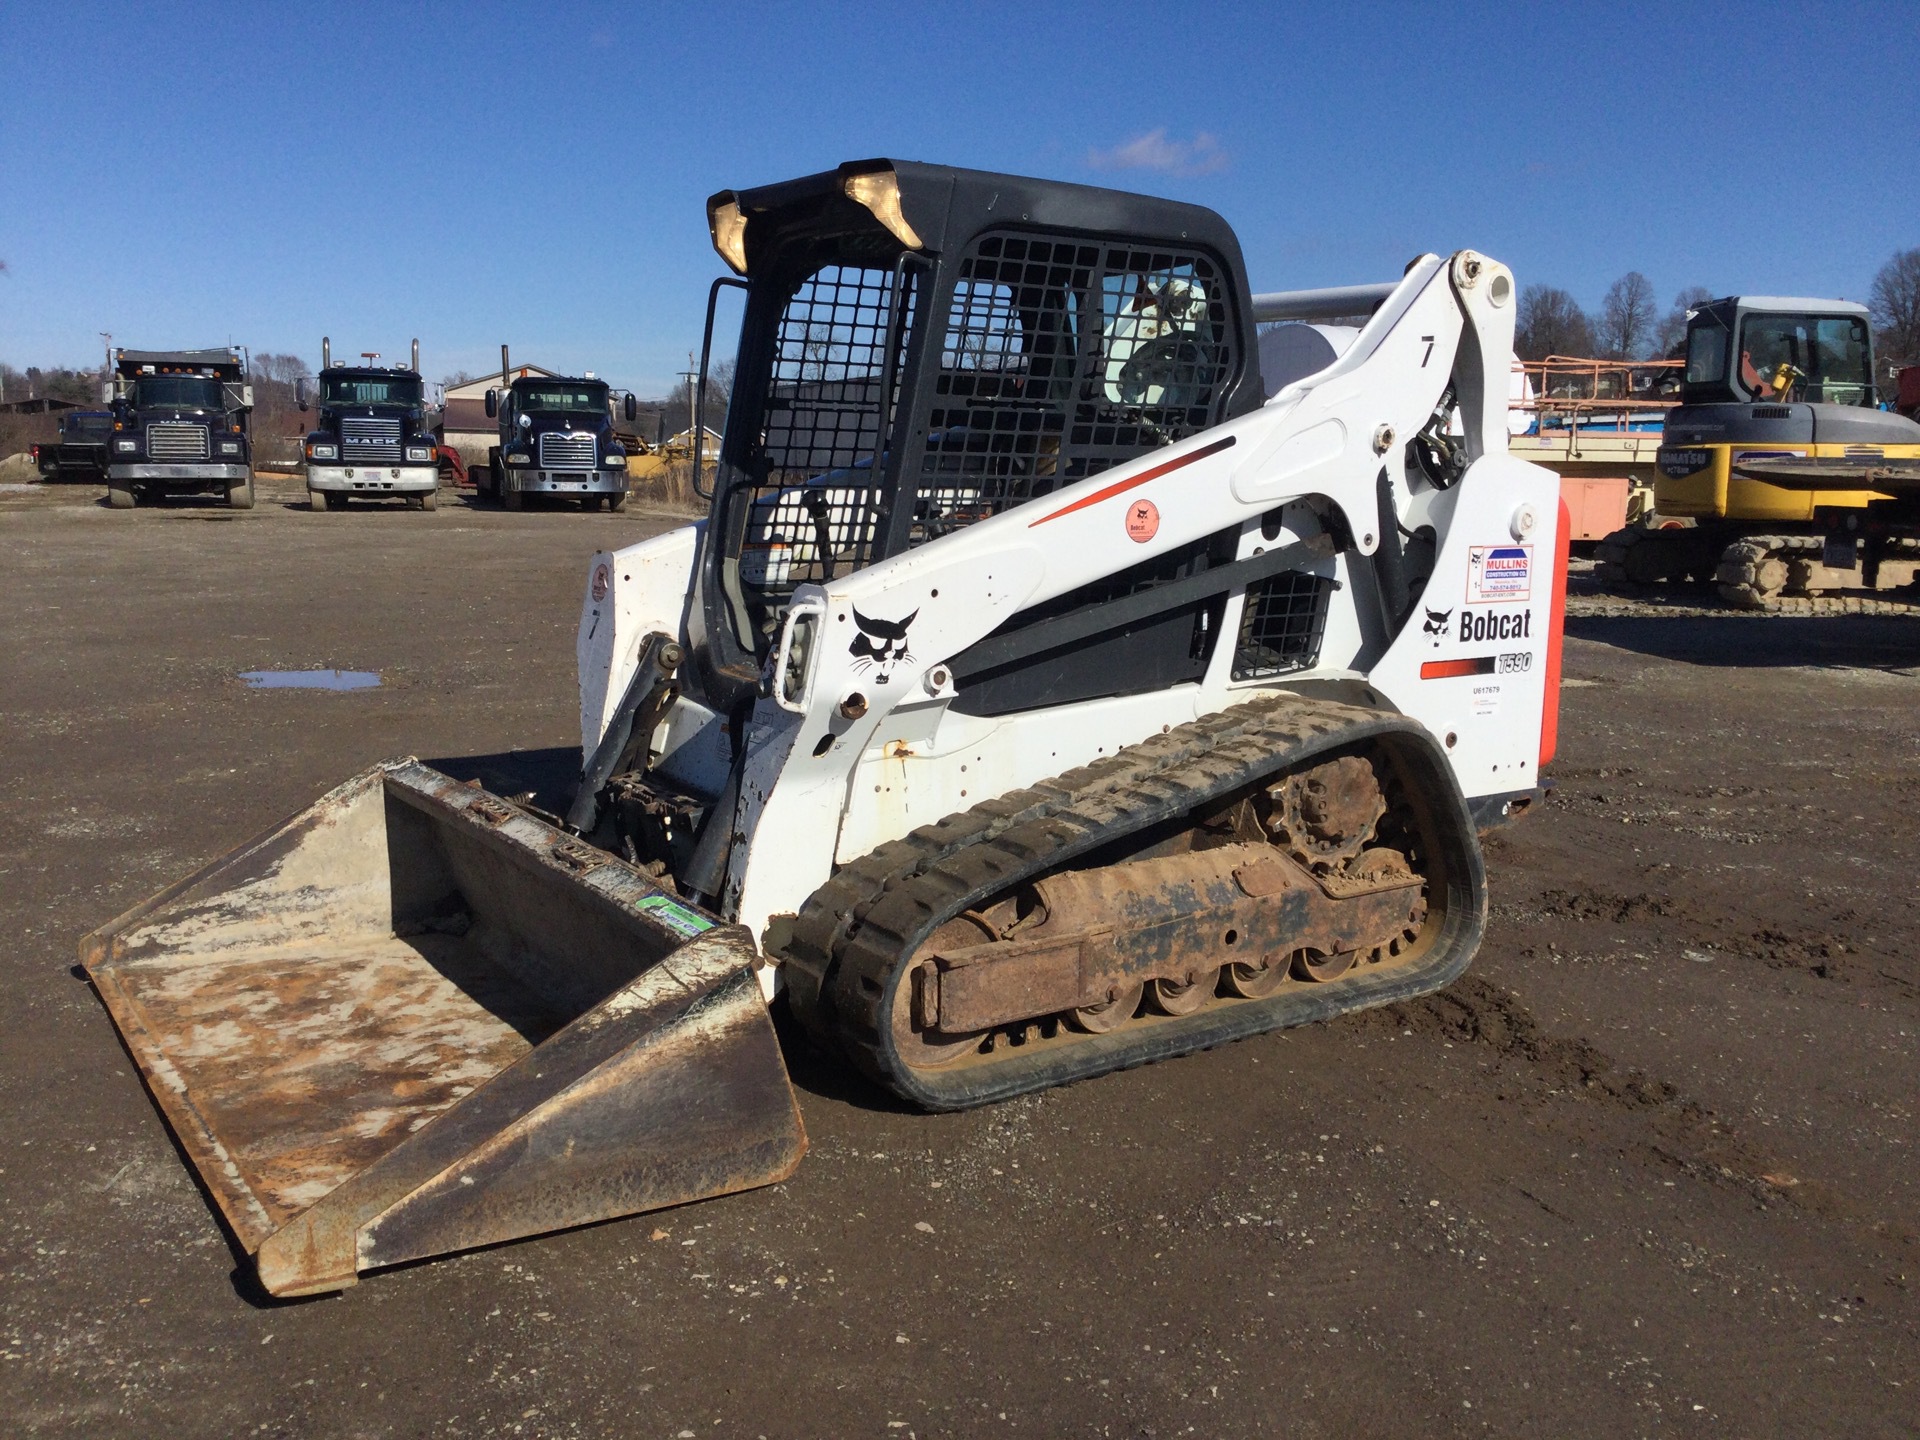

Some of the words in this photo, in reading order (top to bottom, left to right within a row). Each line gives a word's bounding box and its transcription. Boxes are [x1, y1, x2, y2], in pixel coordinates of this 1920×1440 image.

[1421, 335, 1434, 368] 7
[231, 467, 238, 476] 3
[1486, 560, 1528, 569] MULLINS
[1460, 608, 1531, 642] Bobcat
[1498, 652, 1533, 674] T590
[1473, 686, 1500, 695] U617679
